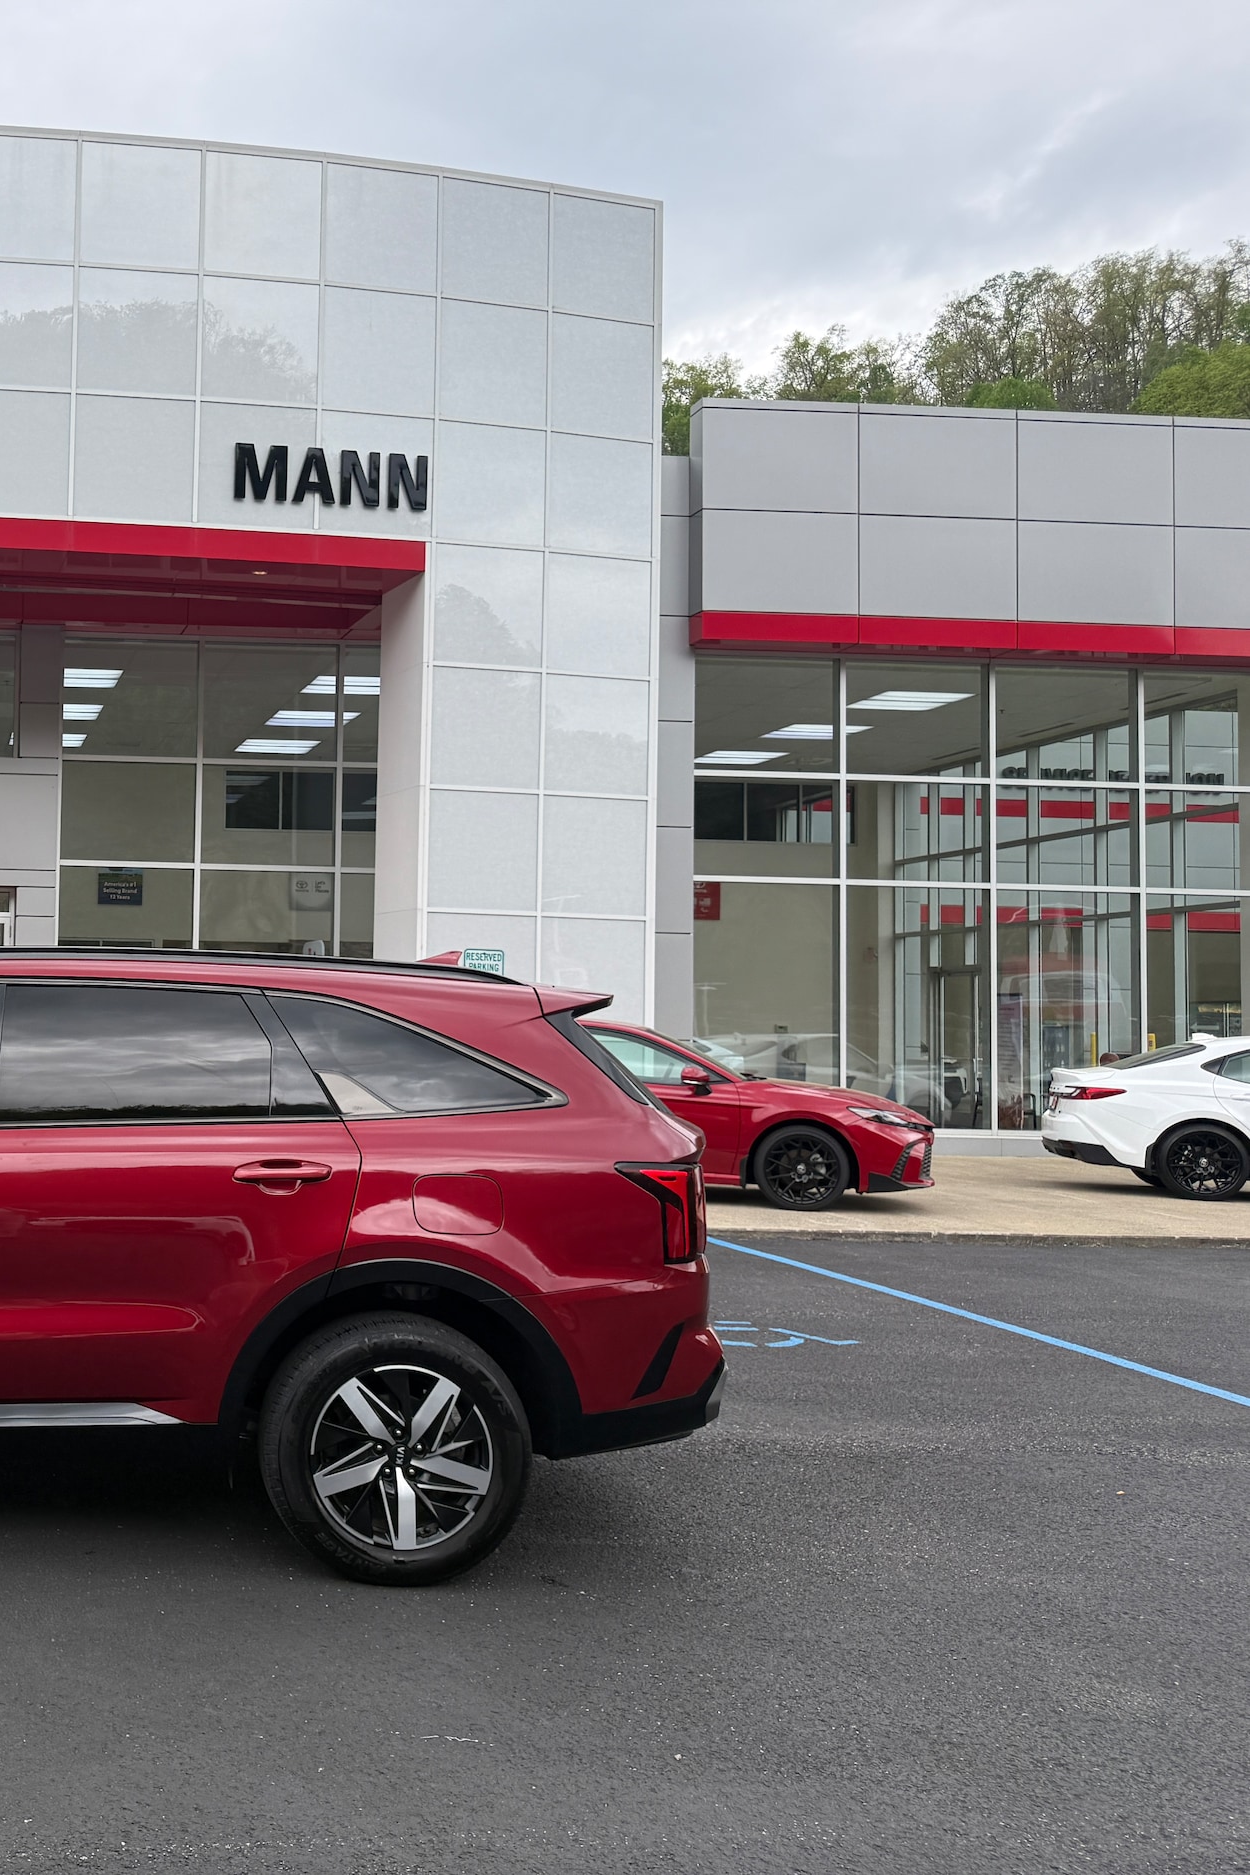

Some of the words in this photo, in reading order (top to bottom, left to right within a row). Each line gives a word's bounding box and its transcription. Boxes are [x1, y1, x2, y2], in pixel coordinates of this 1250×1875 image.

[234, 442, 429, 511] MANN
[466, 951, 502, 962] RESERVED
[468, 962, 500, 972] PARKING
[395, 1446, 406, 1465] KIA
